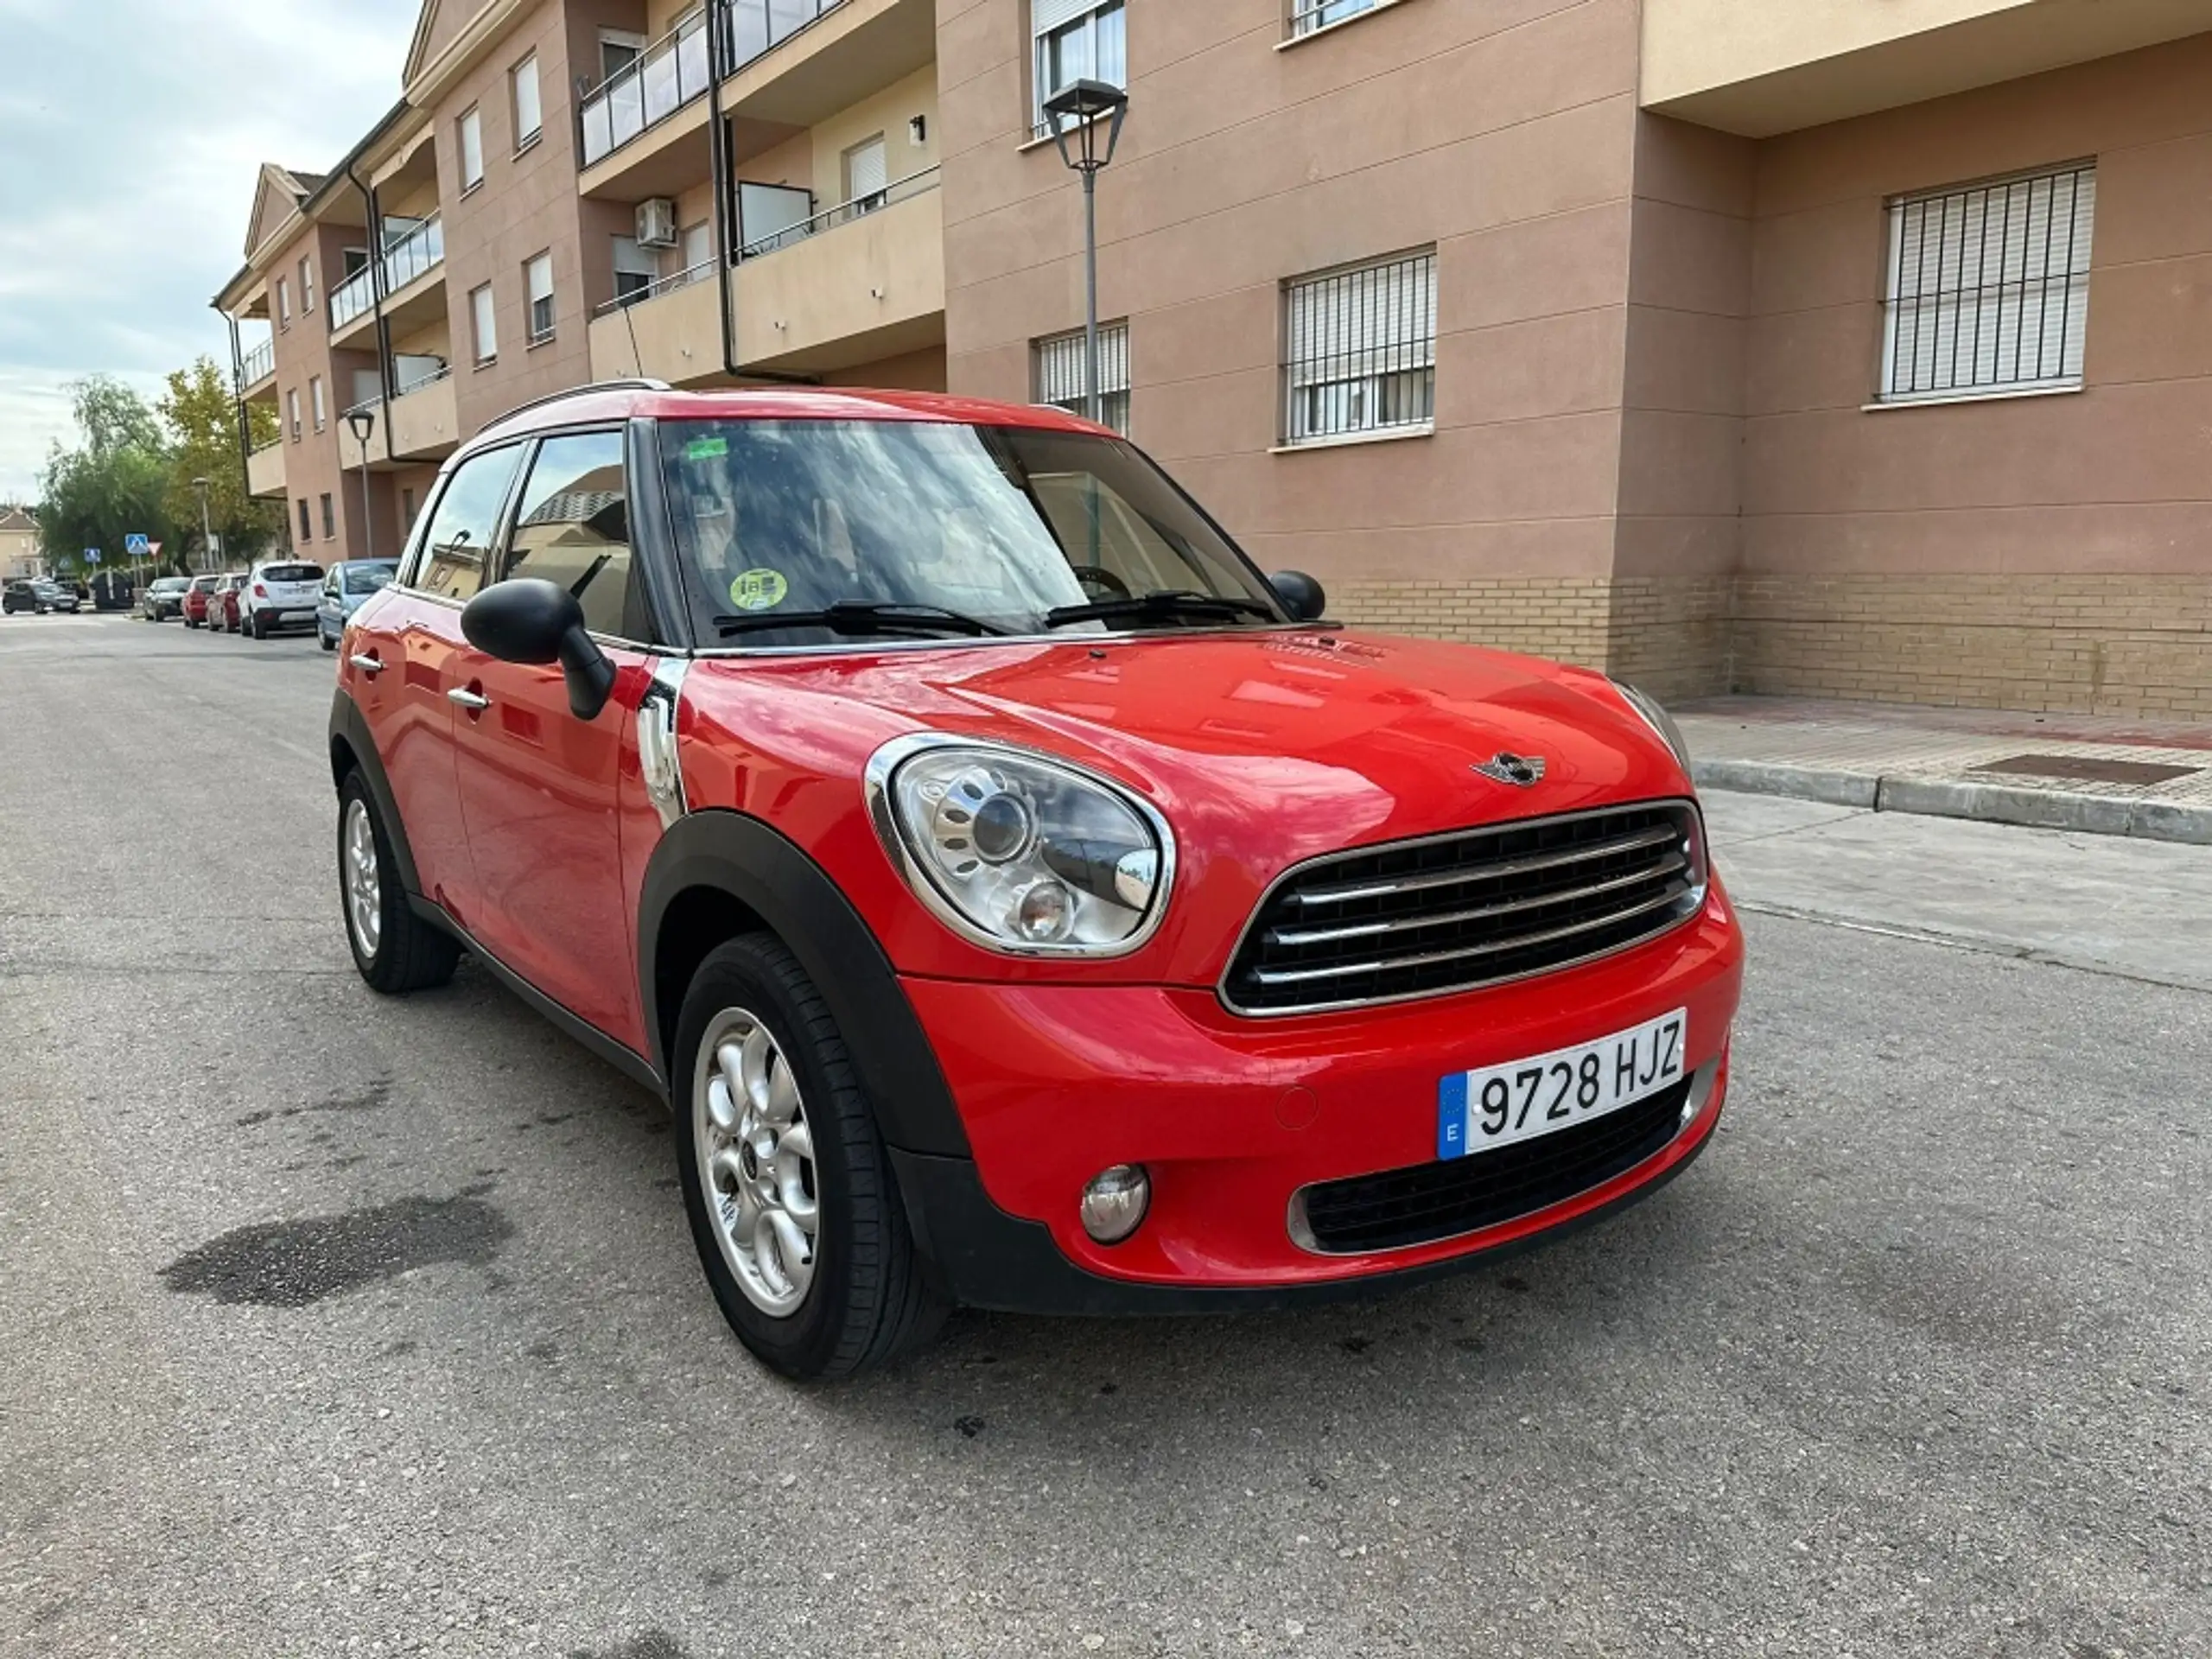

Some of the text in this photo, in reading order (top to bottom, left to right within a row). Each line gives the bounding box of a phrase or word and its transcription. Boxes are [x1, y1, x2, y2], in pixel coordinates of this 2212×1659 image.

[1481, 1020, 1681, 1135] 9728 HJZ
[1446, 1123, 1459, 1141] E
